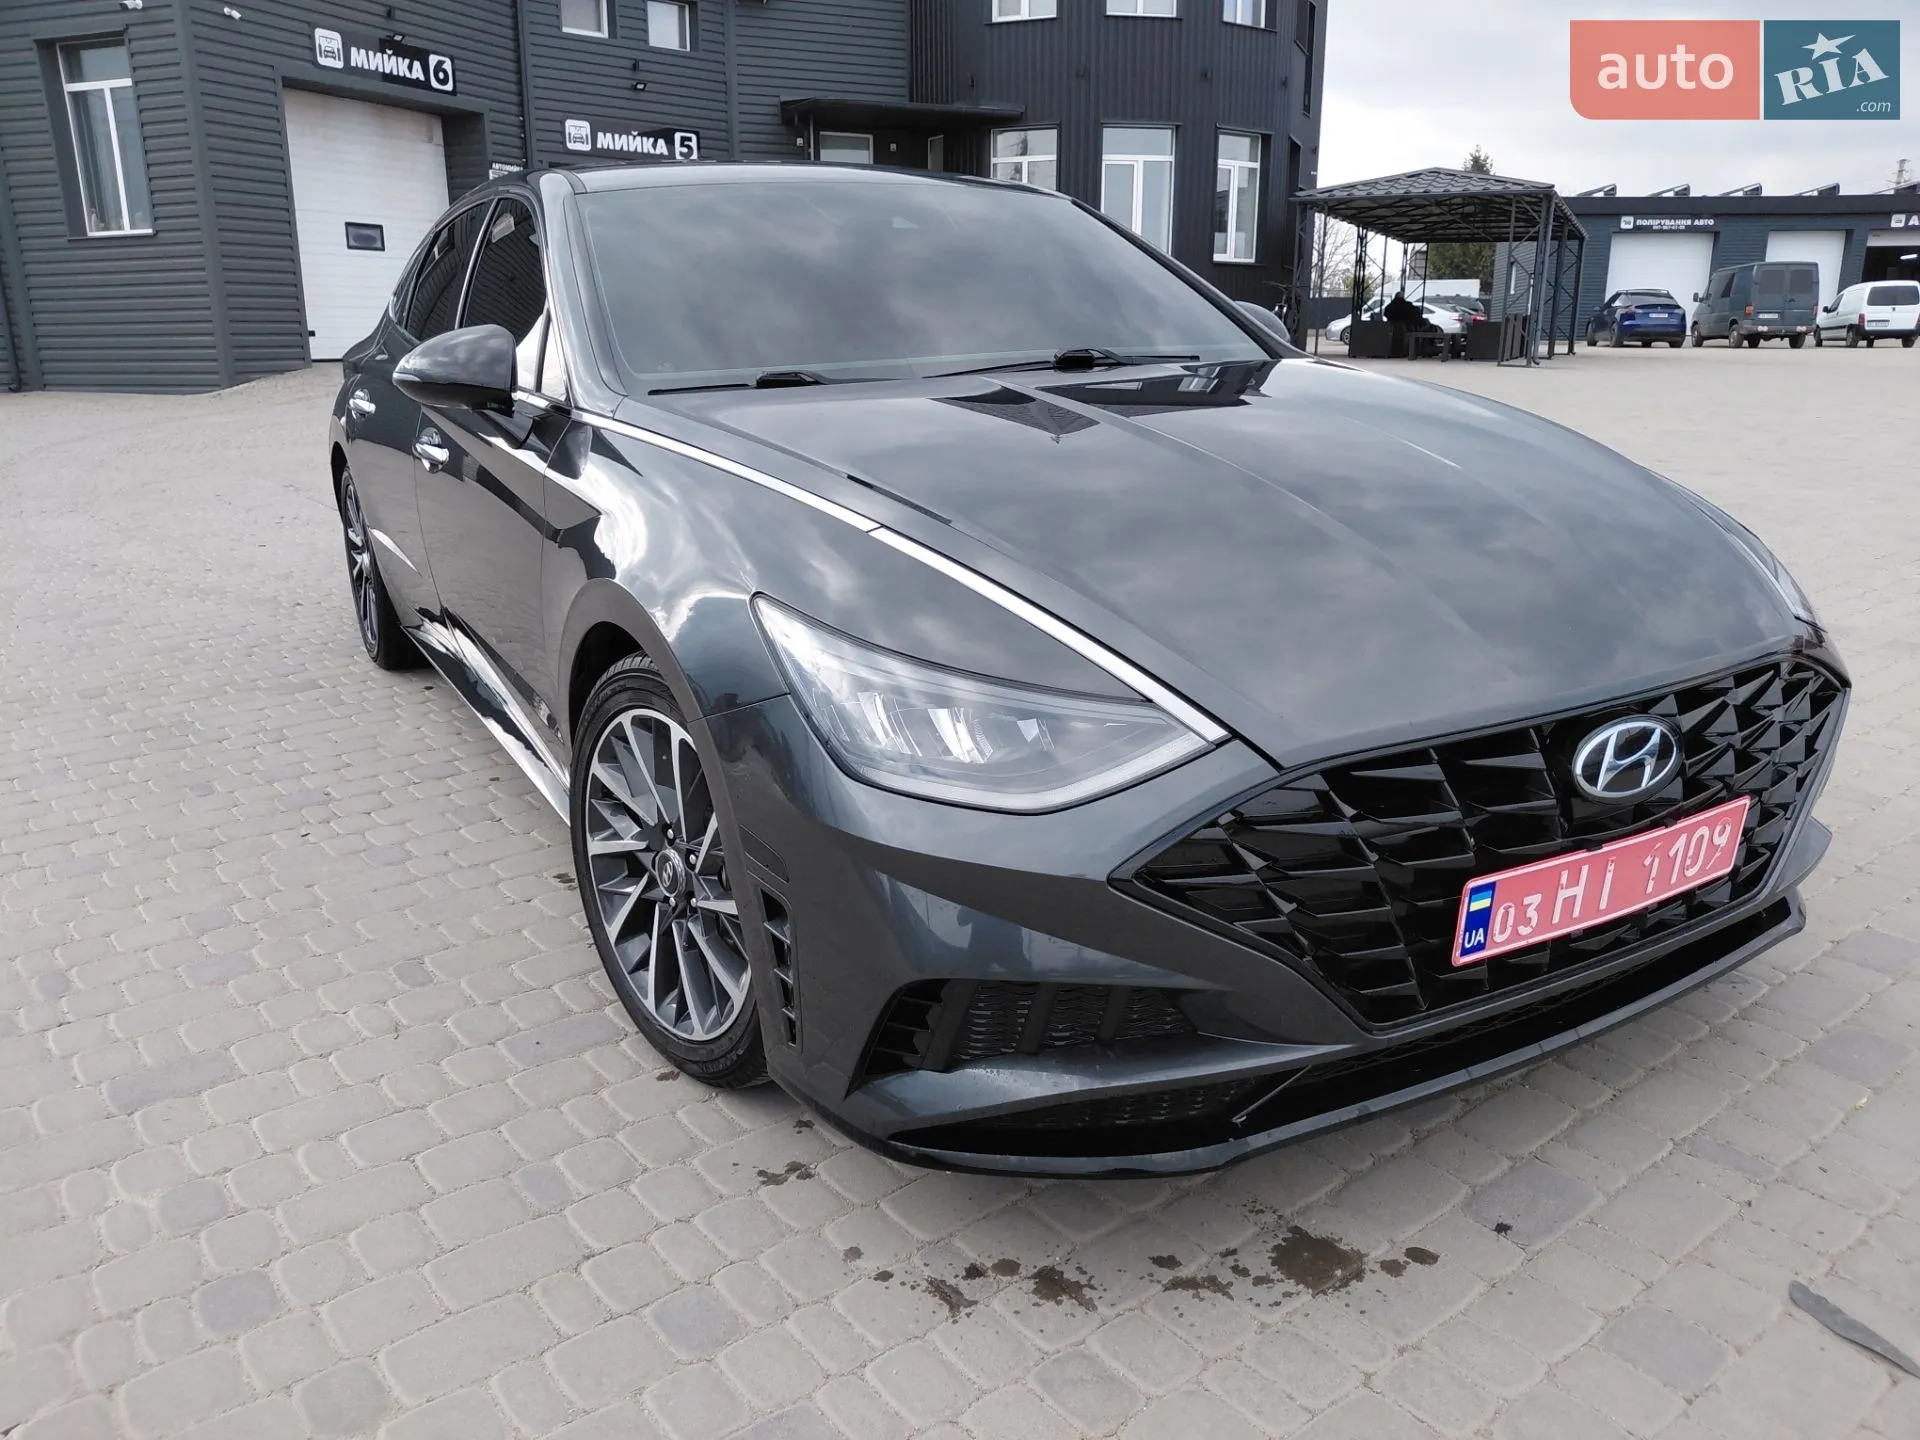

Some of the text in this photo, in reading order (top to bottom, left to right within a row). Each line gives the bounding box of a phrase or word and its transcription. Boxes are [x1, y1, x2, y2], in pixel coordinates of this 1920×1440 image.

[350, 46, 451, 88] МИЙКА 6
[596, 130, 696, 159] МИЙКА 5
[1636, 218, 1715, 226] ПОЛІРУВАННЯ АВТО
[1492, 892, 1543, 944] 03
[1642, 816, 1734, 895] 1109
[1463, 930, 1486, 949] UA
